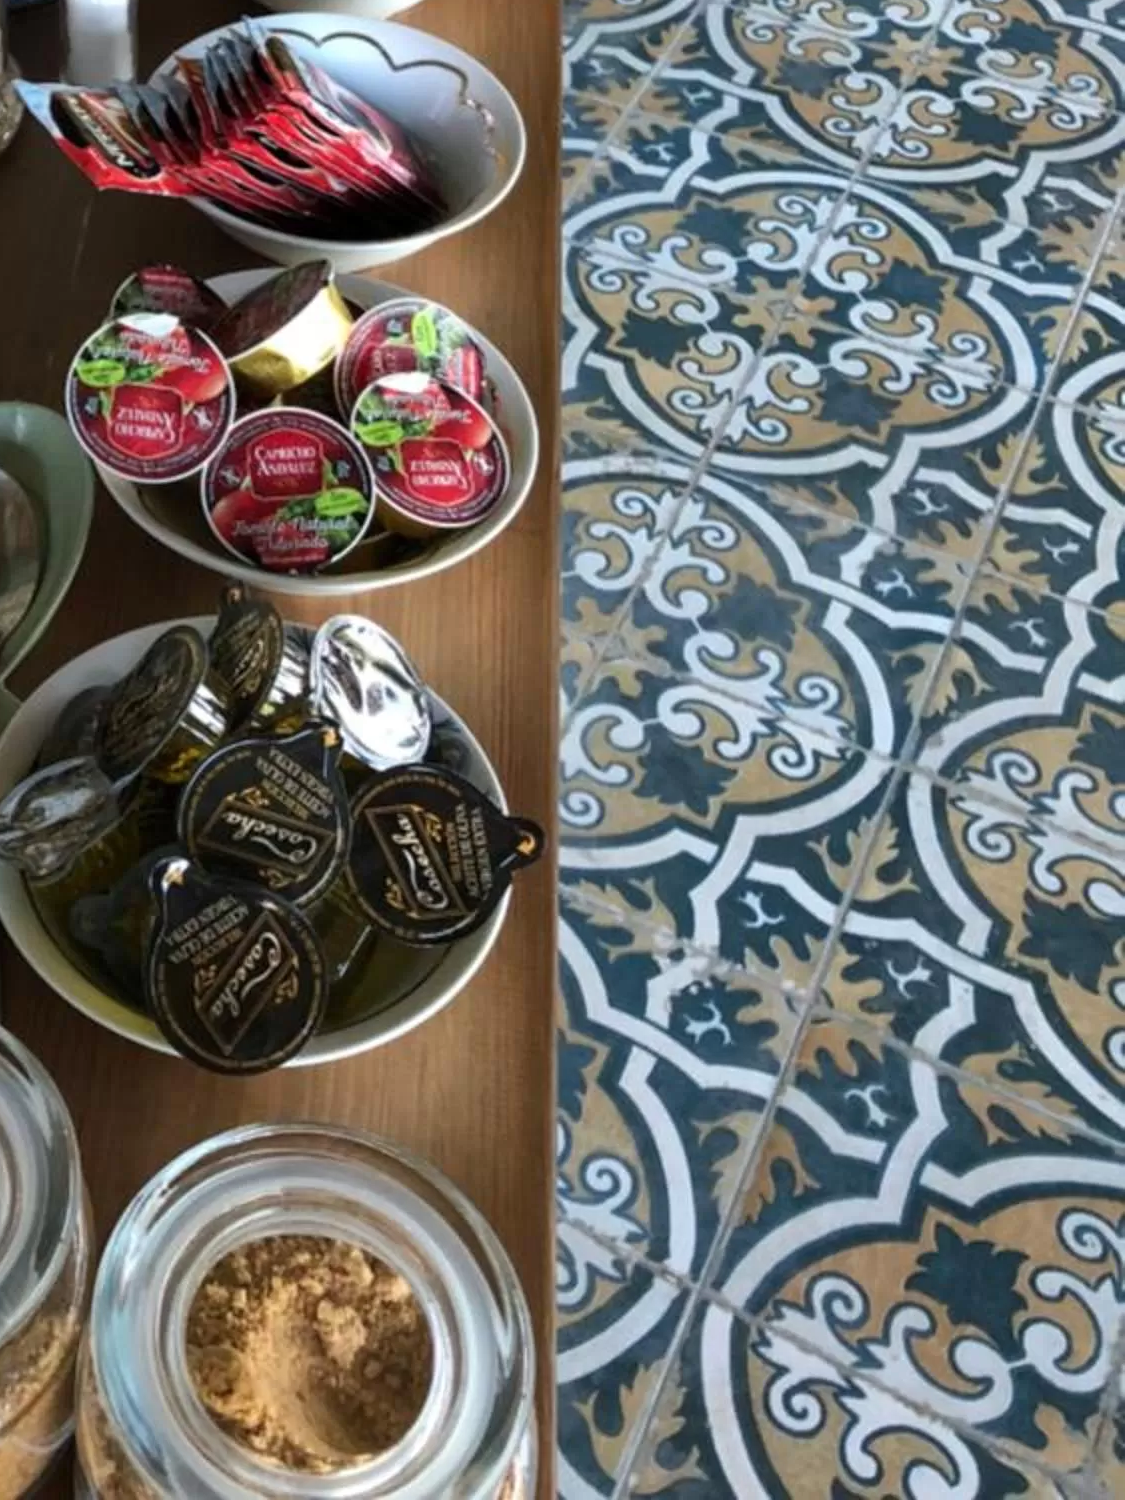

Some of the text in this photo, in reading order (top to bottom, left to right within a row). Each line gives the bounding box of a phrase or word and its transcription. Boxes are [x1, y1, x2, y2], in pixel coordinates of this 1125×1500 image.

[254, 445, 316, 462] CAPRICHO
[221, 811, 318, 864] Cosecha
[391, 812, 449, 909] Cosecha
[211, 931, 282, 1018] Cosecha
